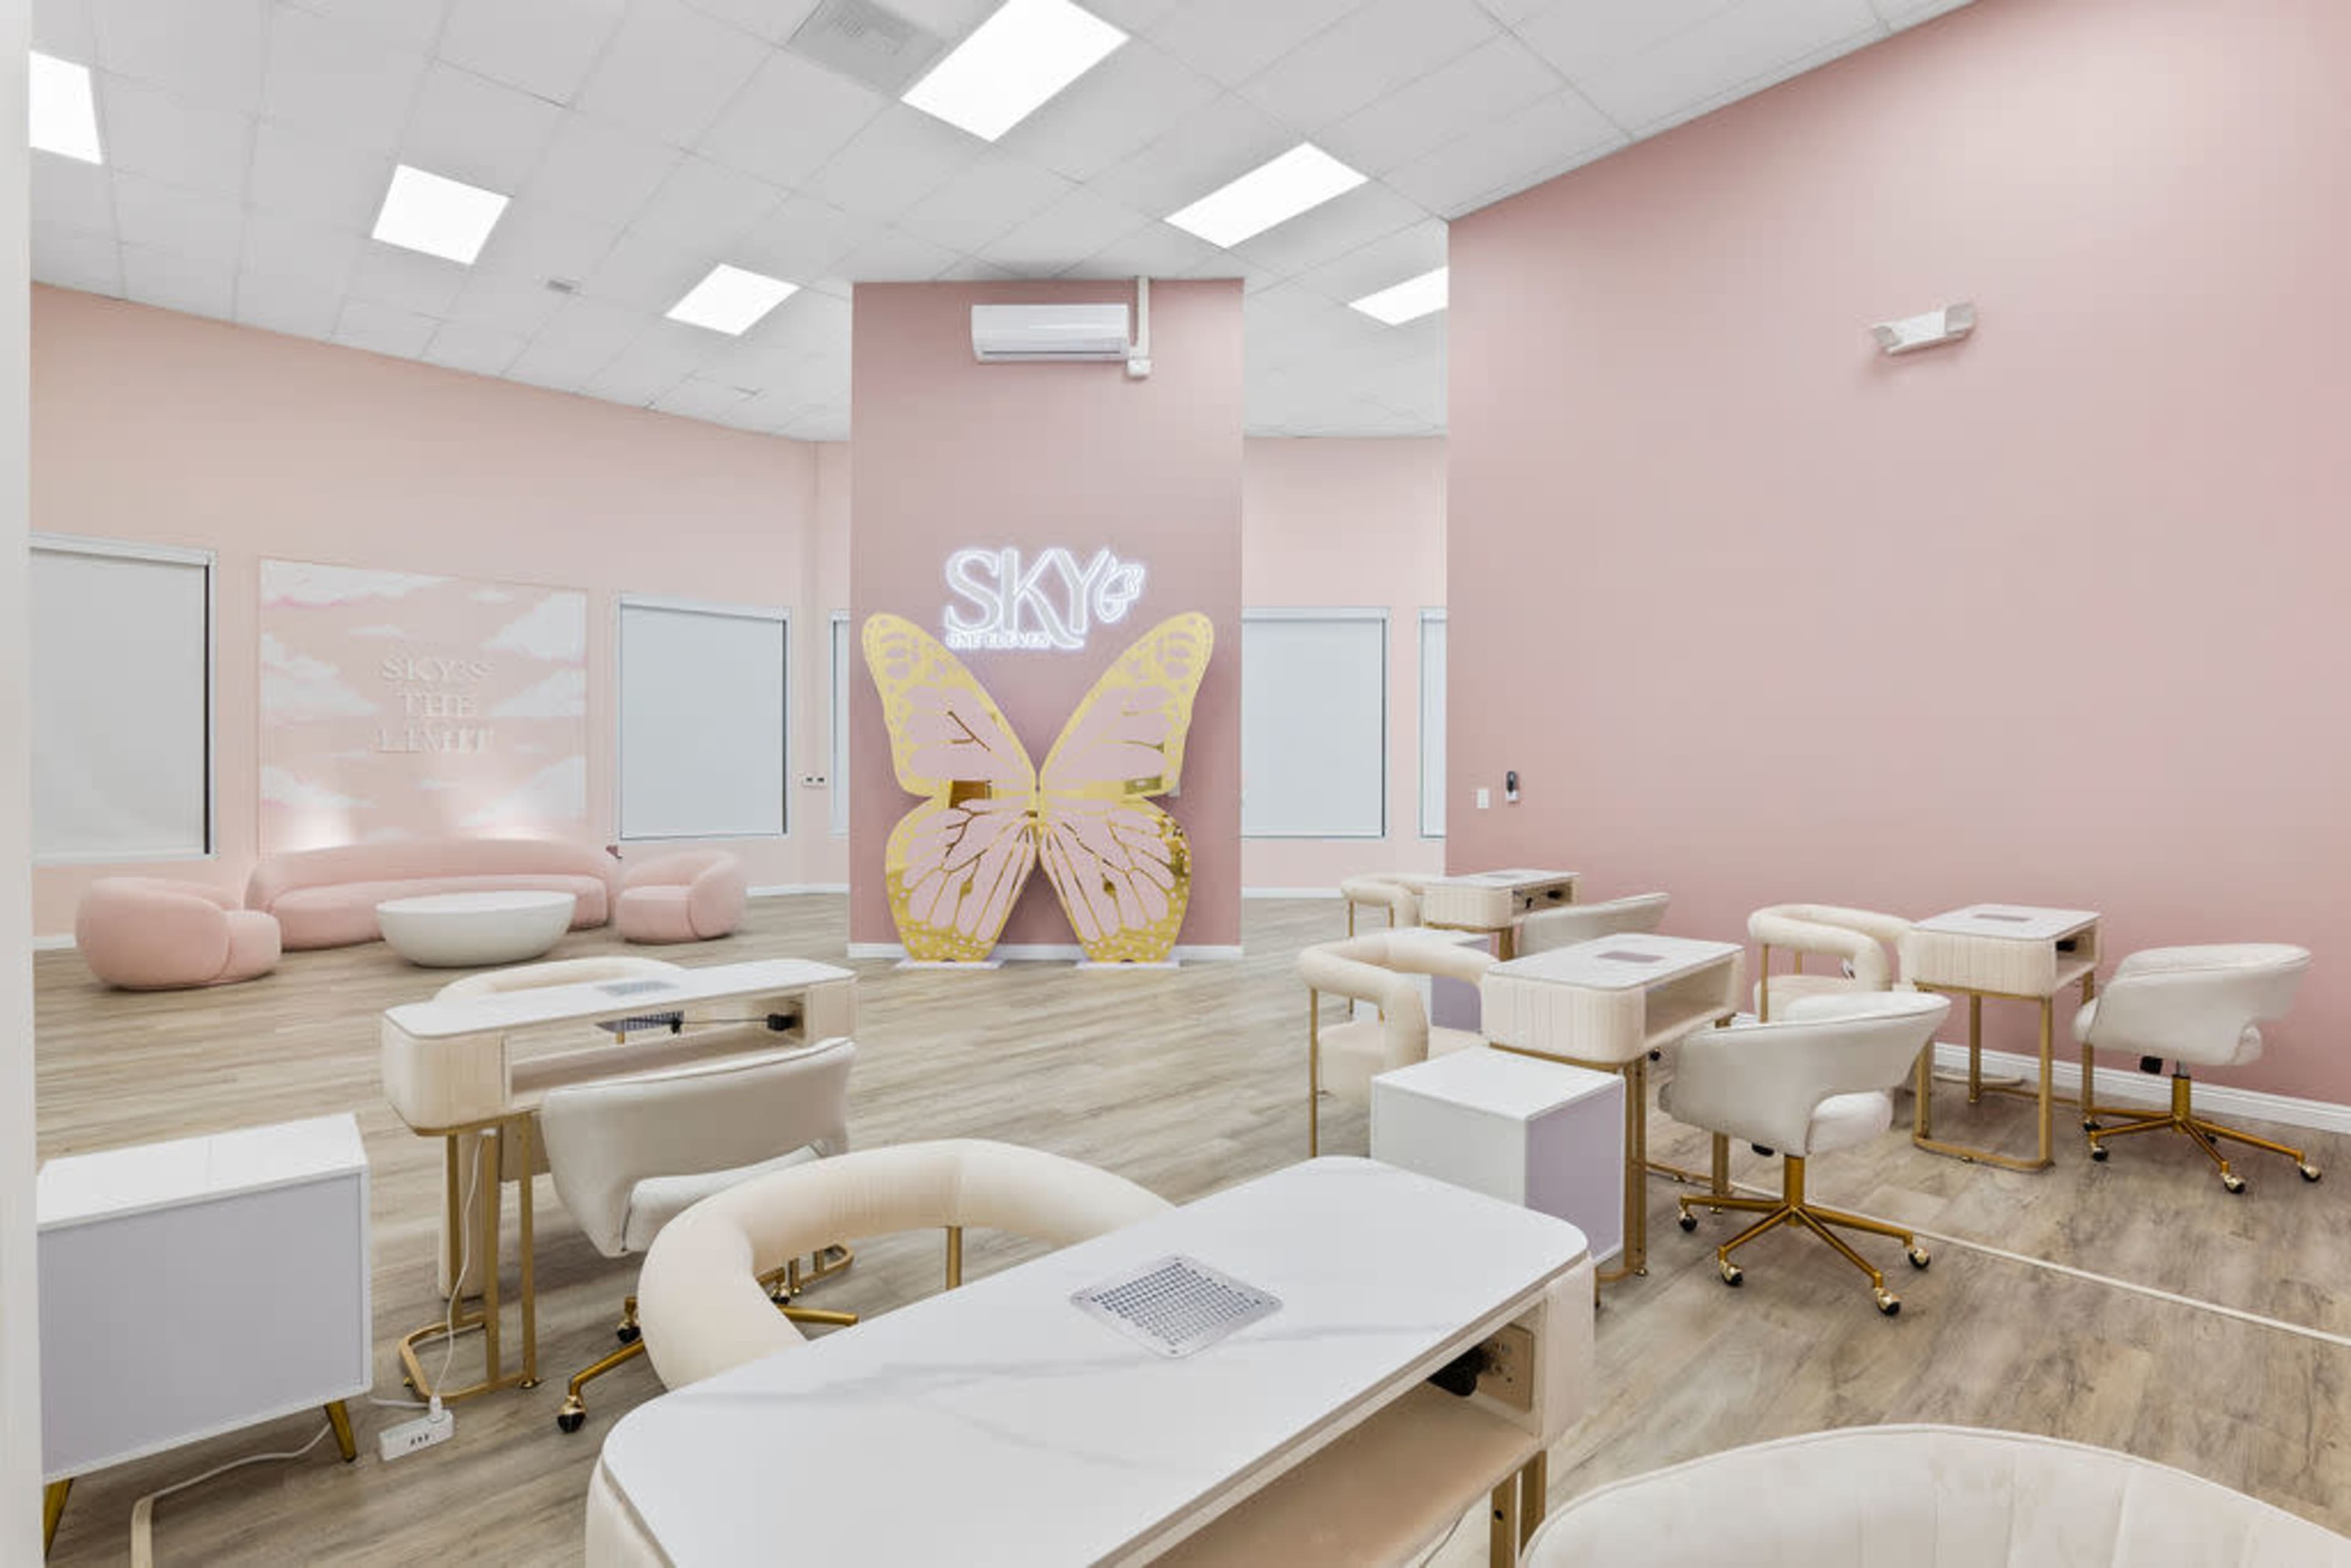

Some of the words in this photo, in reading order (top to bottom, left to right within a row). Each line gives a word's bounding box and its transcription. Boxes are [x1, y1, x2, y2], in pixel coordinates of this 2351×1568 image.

[945, 548, 1110, 648] SKY
[382, 658, 493, 681] SKY'S
[398, 692, 478, 716] THE
[375, 727, 495, 754] LIMIT
